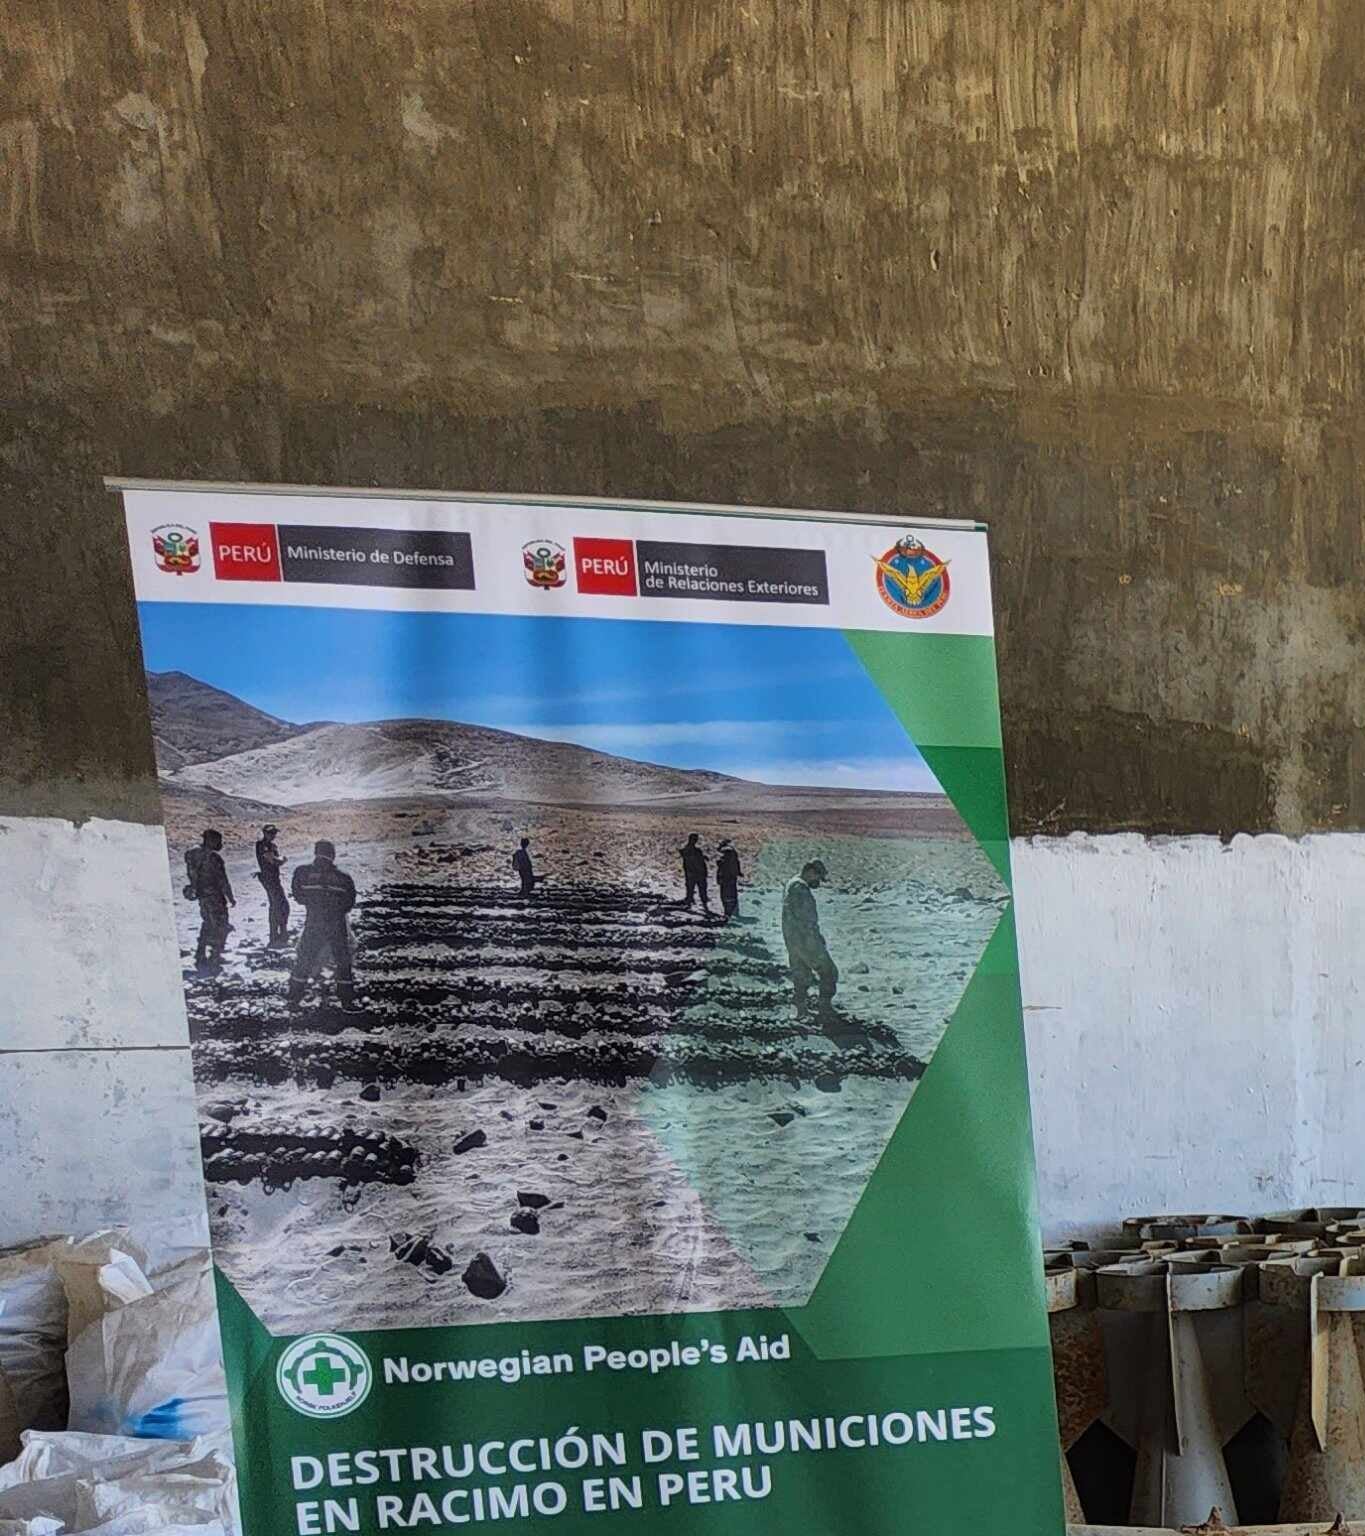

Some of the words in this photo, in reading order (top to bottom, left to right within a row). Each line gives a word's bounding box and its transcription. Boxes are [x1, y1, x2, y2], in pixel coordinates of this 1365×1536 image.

[217, 541, 272, 563] PERÚ
[286, 544, 366, 563] Ministerio
[368, 548, 390, 564] de
[392, 549, 455, 566] Defensa
[580, 555, 628, 576] PERÚ
[643, 560, 718, 580] Ministerio
[644, 575, 664, 588] de
[667, 574, 745, 593] Relaciones
[746, 579, 819, 596] Exteriores
[382, 1348, 574, 1384] Norwegian
[582, 1337, 728, 1374] People's
[735, 1333, 791, 1362] Aid
[289, 1431, 627, 1490] DESTRUCCIÓN
[641, 1426, 700, 1463] DE
[712, 1404, 996, 1458] MUNICIONES
[295, 1496, 360, 1536] EN
[375, 1480, 567, 1529] RACIMO
[582, 1474, 643, 1512] EN
[657, 1464, 772, 1506] PERU
